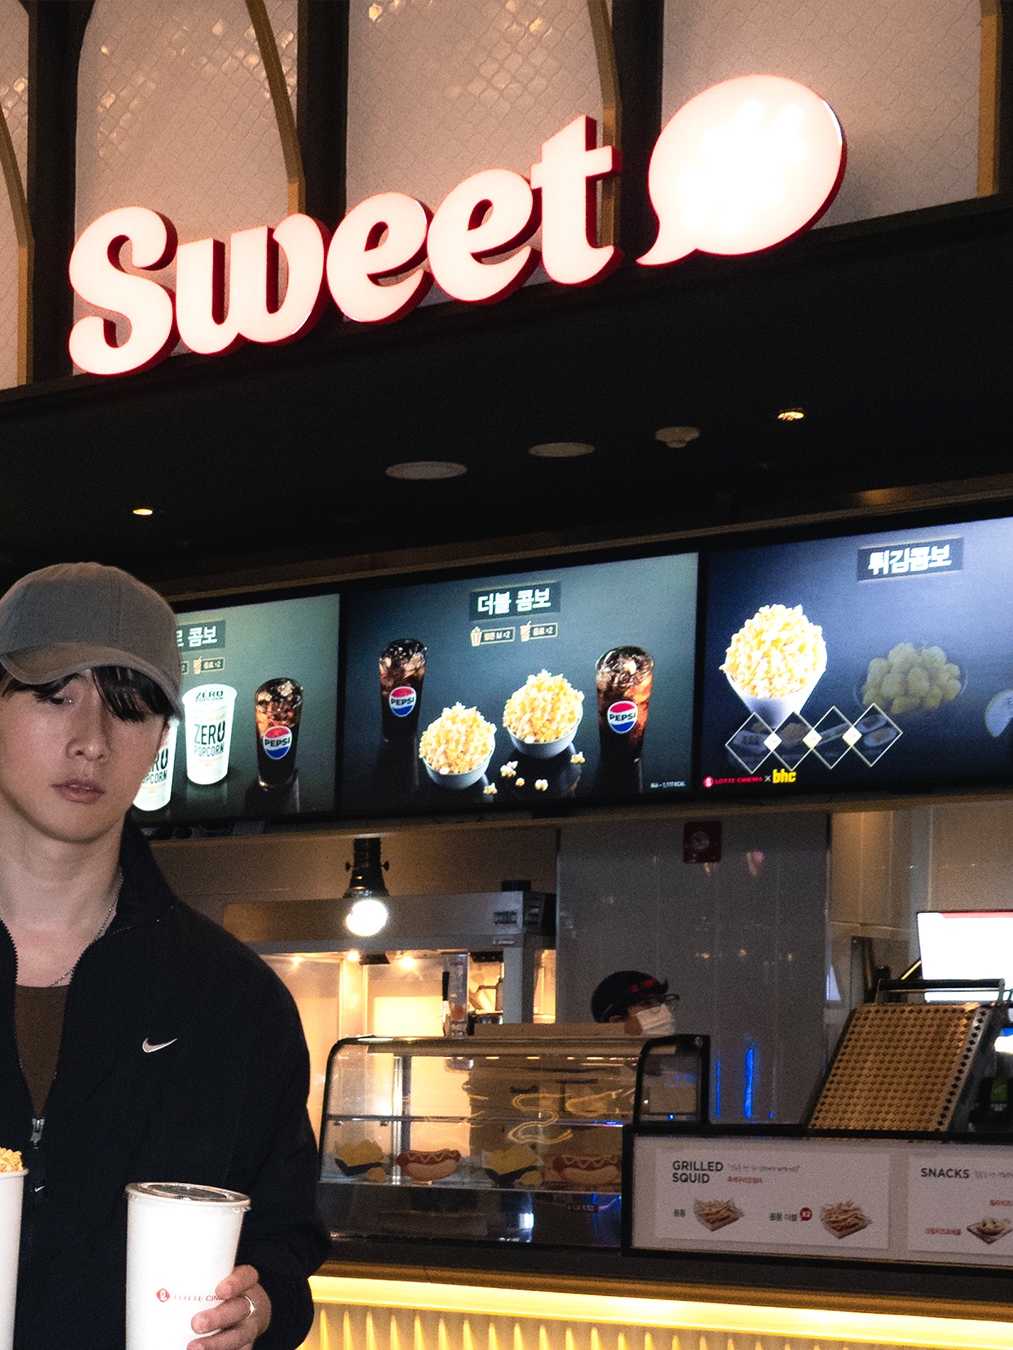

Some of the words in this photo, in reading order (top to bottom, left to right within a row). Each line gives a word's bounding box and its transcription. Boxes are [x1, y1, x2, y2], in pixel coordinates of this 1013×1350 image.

[68, 113, 624, 378] Sweet
[868, 544, 952, 576] 튀김콤보
[477, 591, 512, 615] 더블
[515, 587, 551, 612] 콤보
[187, 625, 218, 648] 콤보
[391, 697, 415, 706] PEPSI
[608, 713, 636, 722] PEPSI
[194, 720, 226, 746] ZERO
[264, 737, 291, 748] PEPSI
[194, 743, 225, 757] POPCORN
[772, 768, 797, 784] bhc
[671, 1160, 724, 1172] GRILLED
[920, 1167, 970, 1179] SNACKS
[671, 1172, 711, 1184] SQUID
